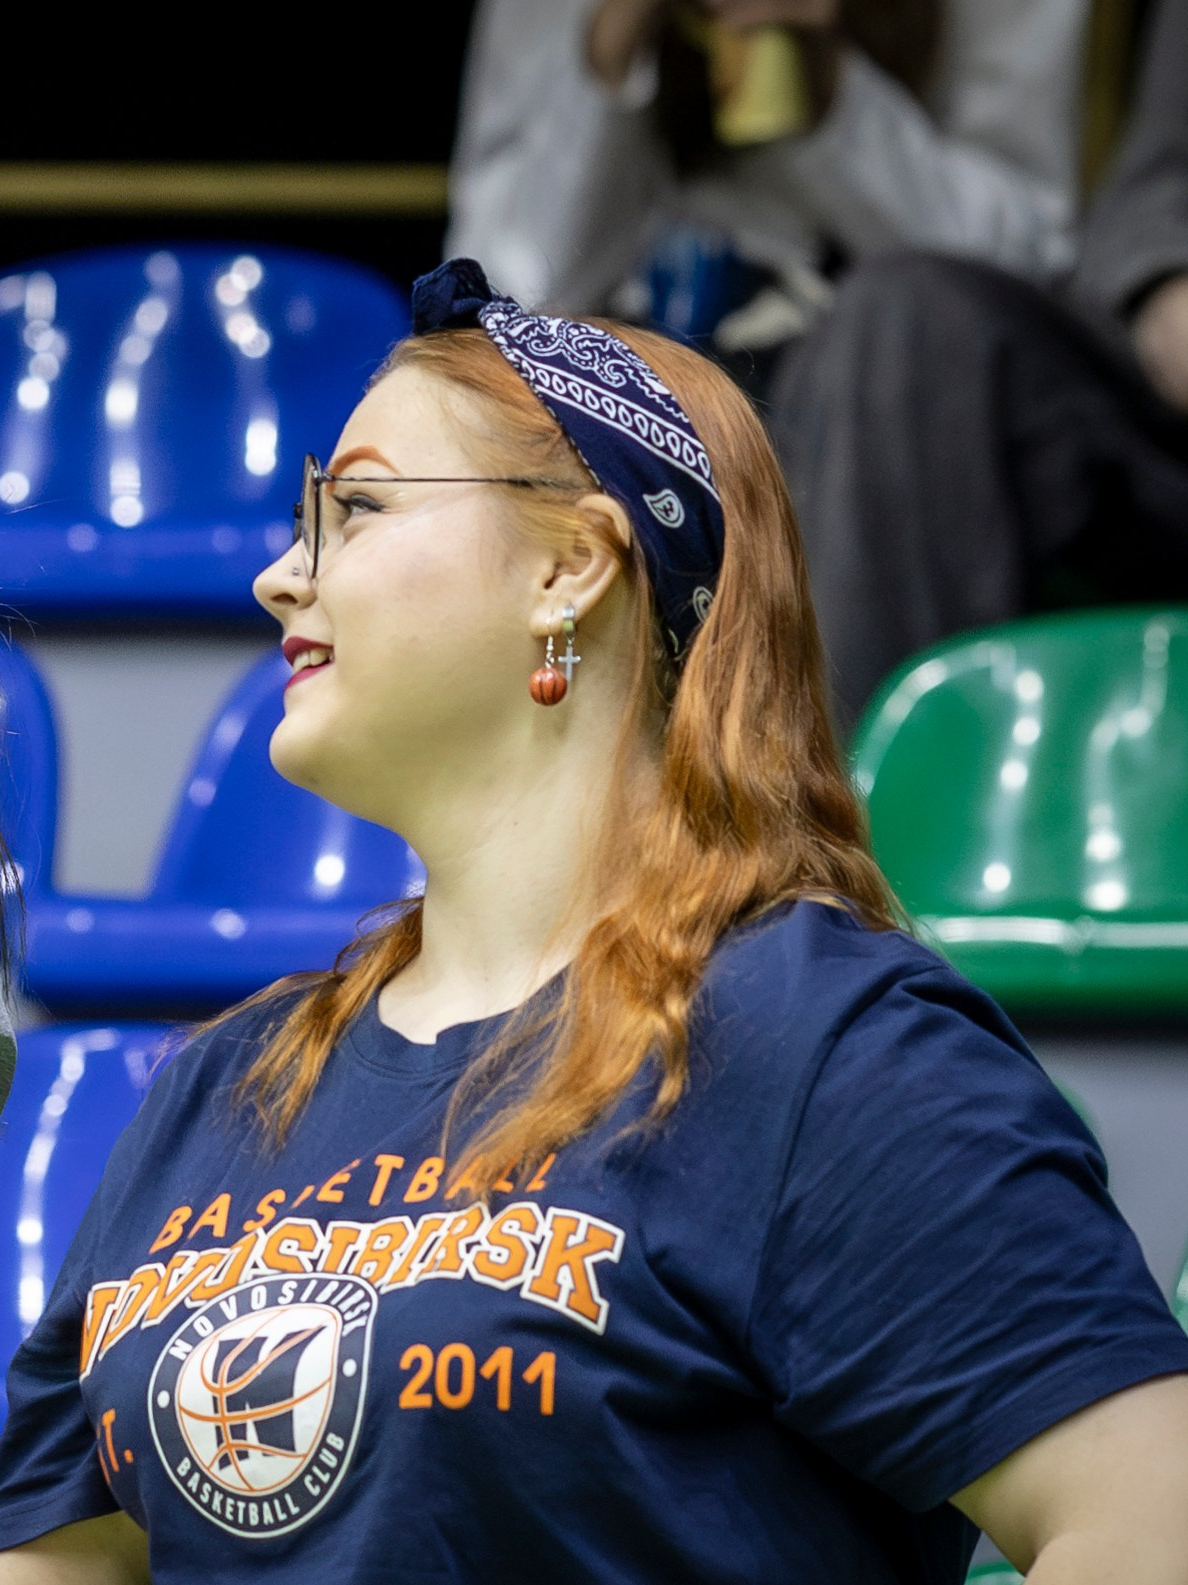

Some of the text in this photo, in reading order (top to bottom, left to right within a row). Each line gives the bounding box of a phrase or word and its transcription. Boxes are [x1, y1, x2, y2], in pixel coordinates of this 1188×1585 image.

[169, 1280, 371, 1361] NOVOSIBIRSK
[398, 1342, 556, 1416] 2011
[176, 1432, 346, 1527] BASKETBALL CLUB
